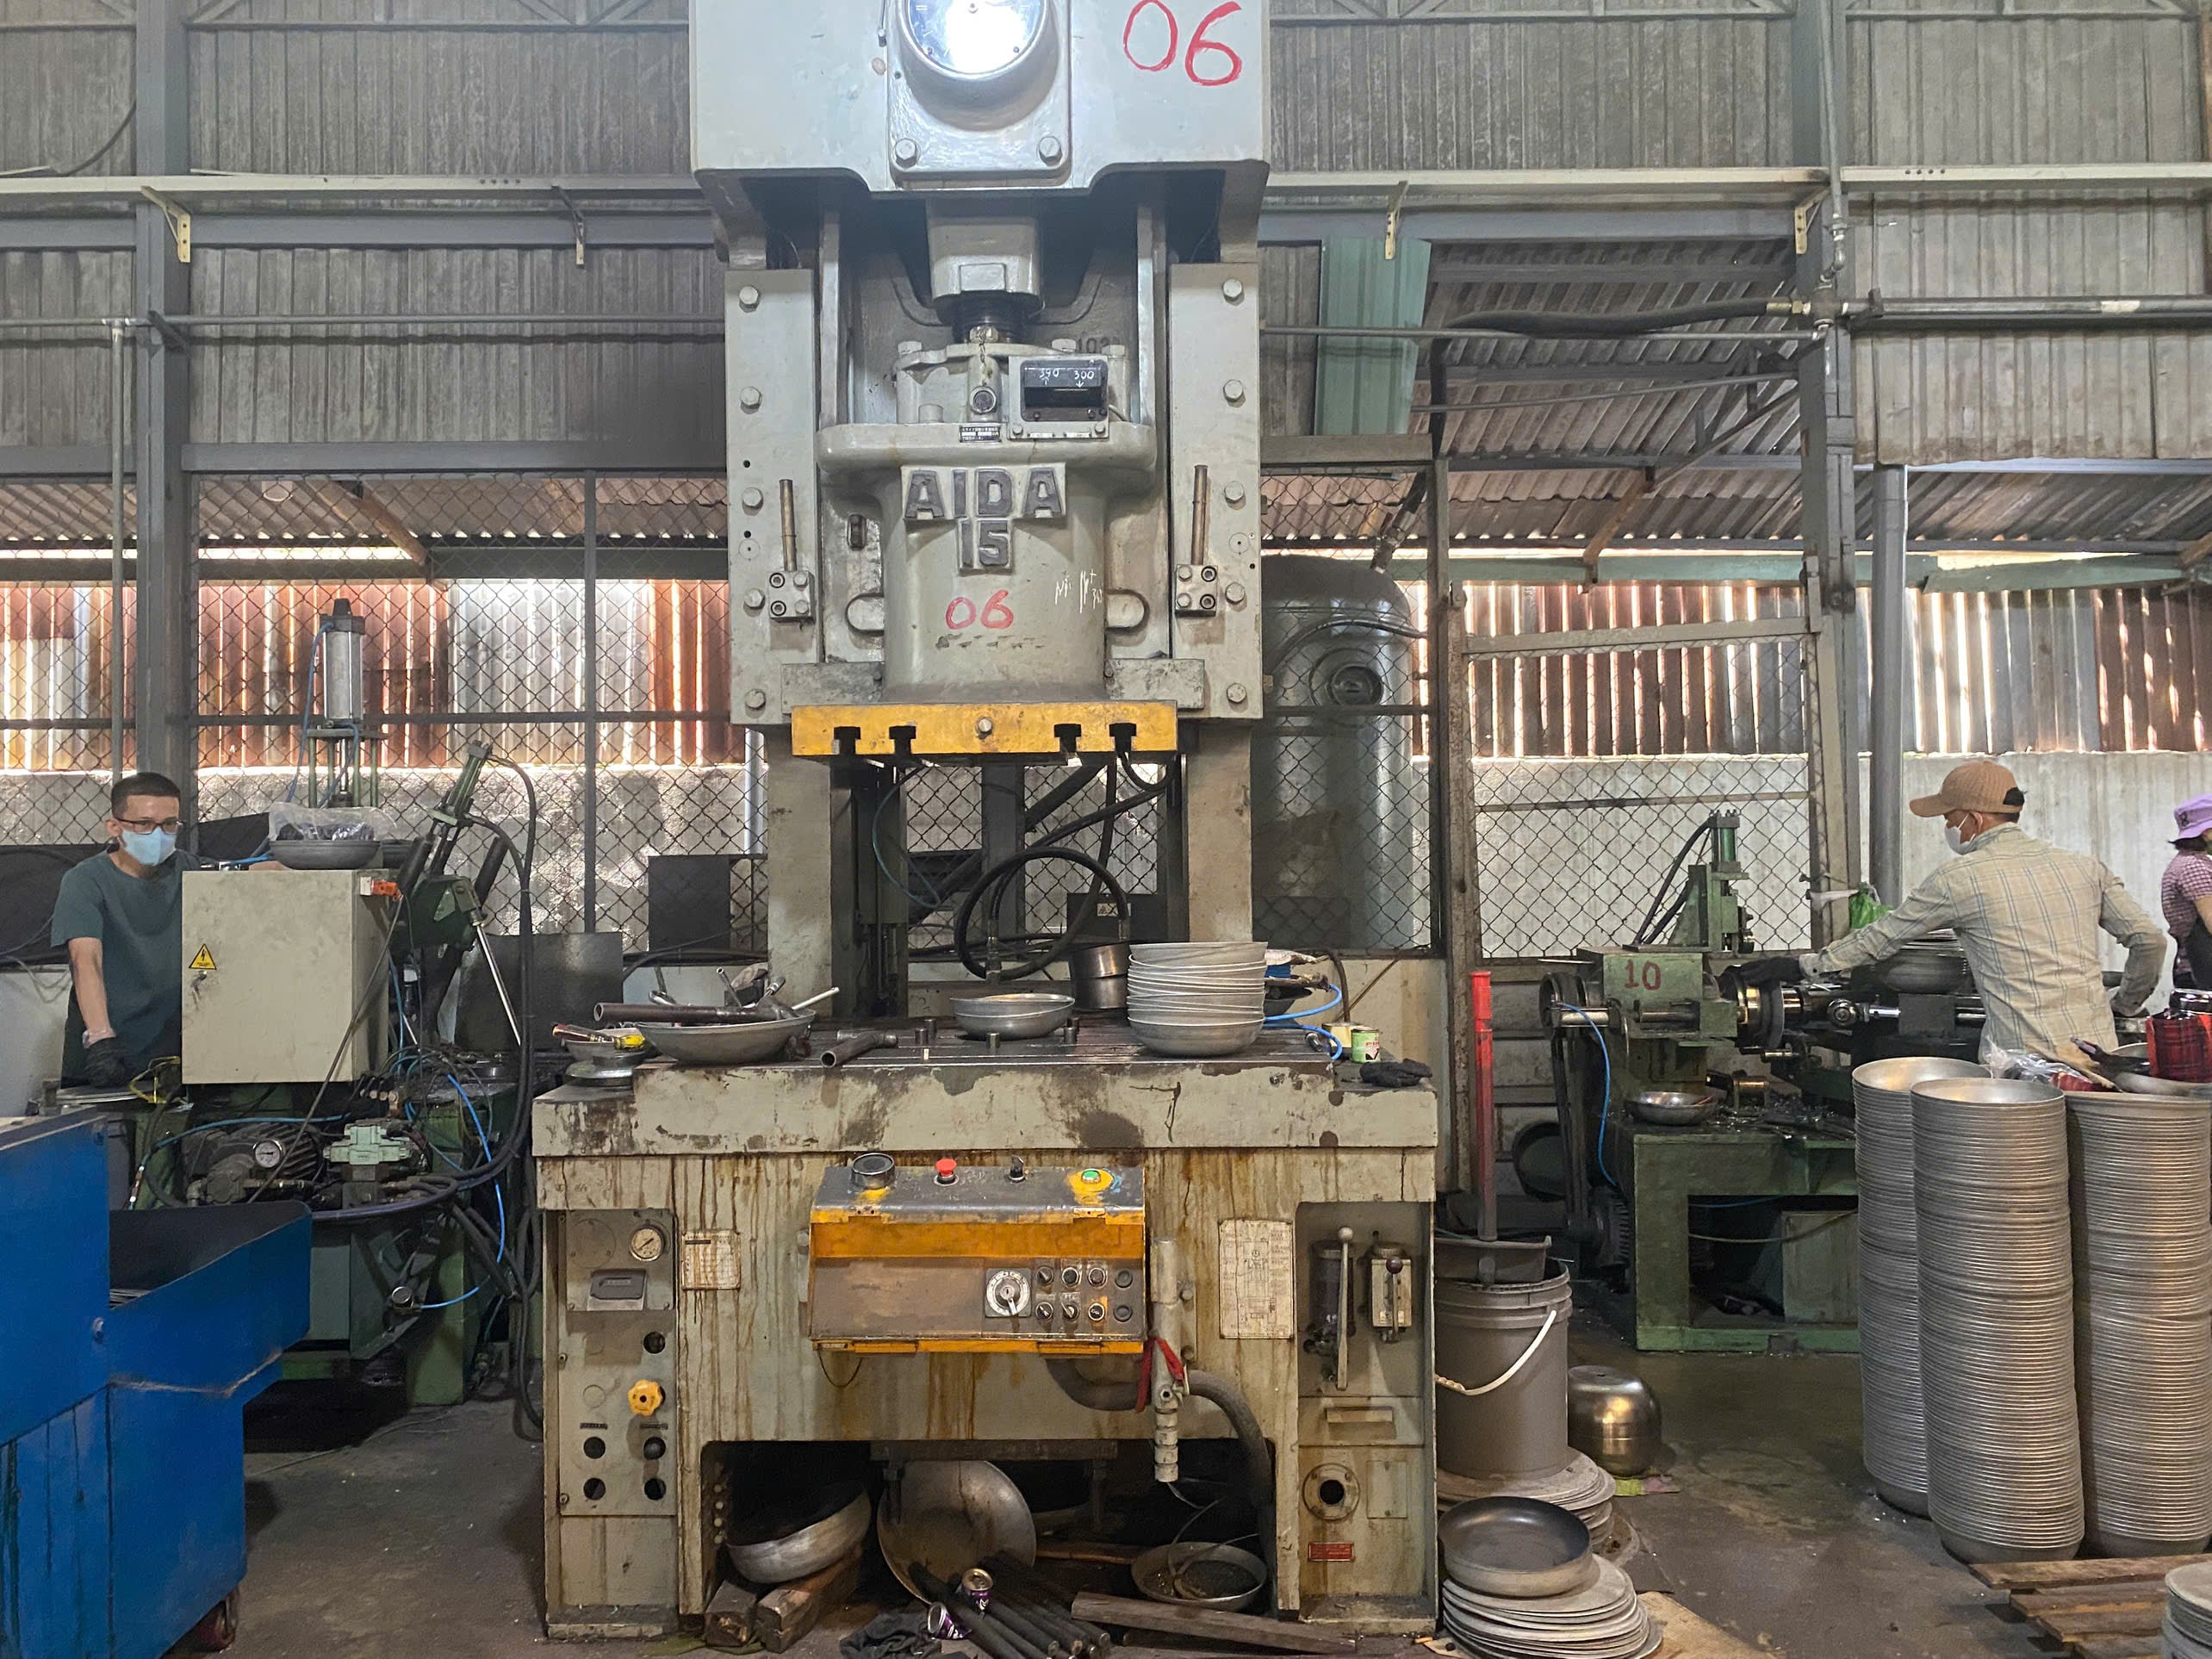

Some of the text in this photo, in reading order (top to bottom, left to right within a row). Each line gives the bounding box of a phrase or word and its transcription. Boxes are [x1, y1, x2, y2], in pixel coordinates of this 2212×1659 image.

[1123, 0, 1242, 86] 06
[1074, 370, 1095, 379] 300
[904, 468, 1063, 518] AIDA
[960, 519, 1009, 568] 15
[946, 589, 1015, 630] 06
[1625, 959, 1662, 991] 10
